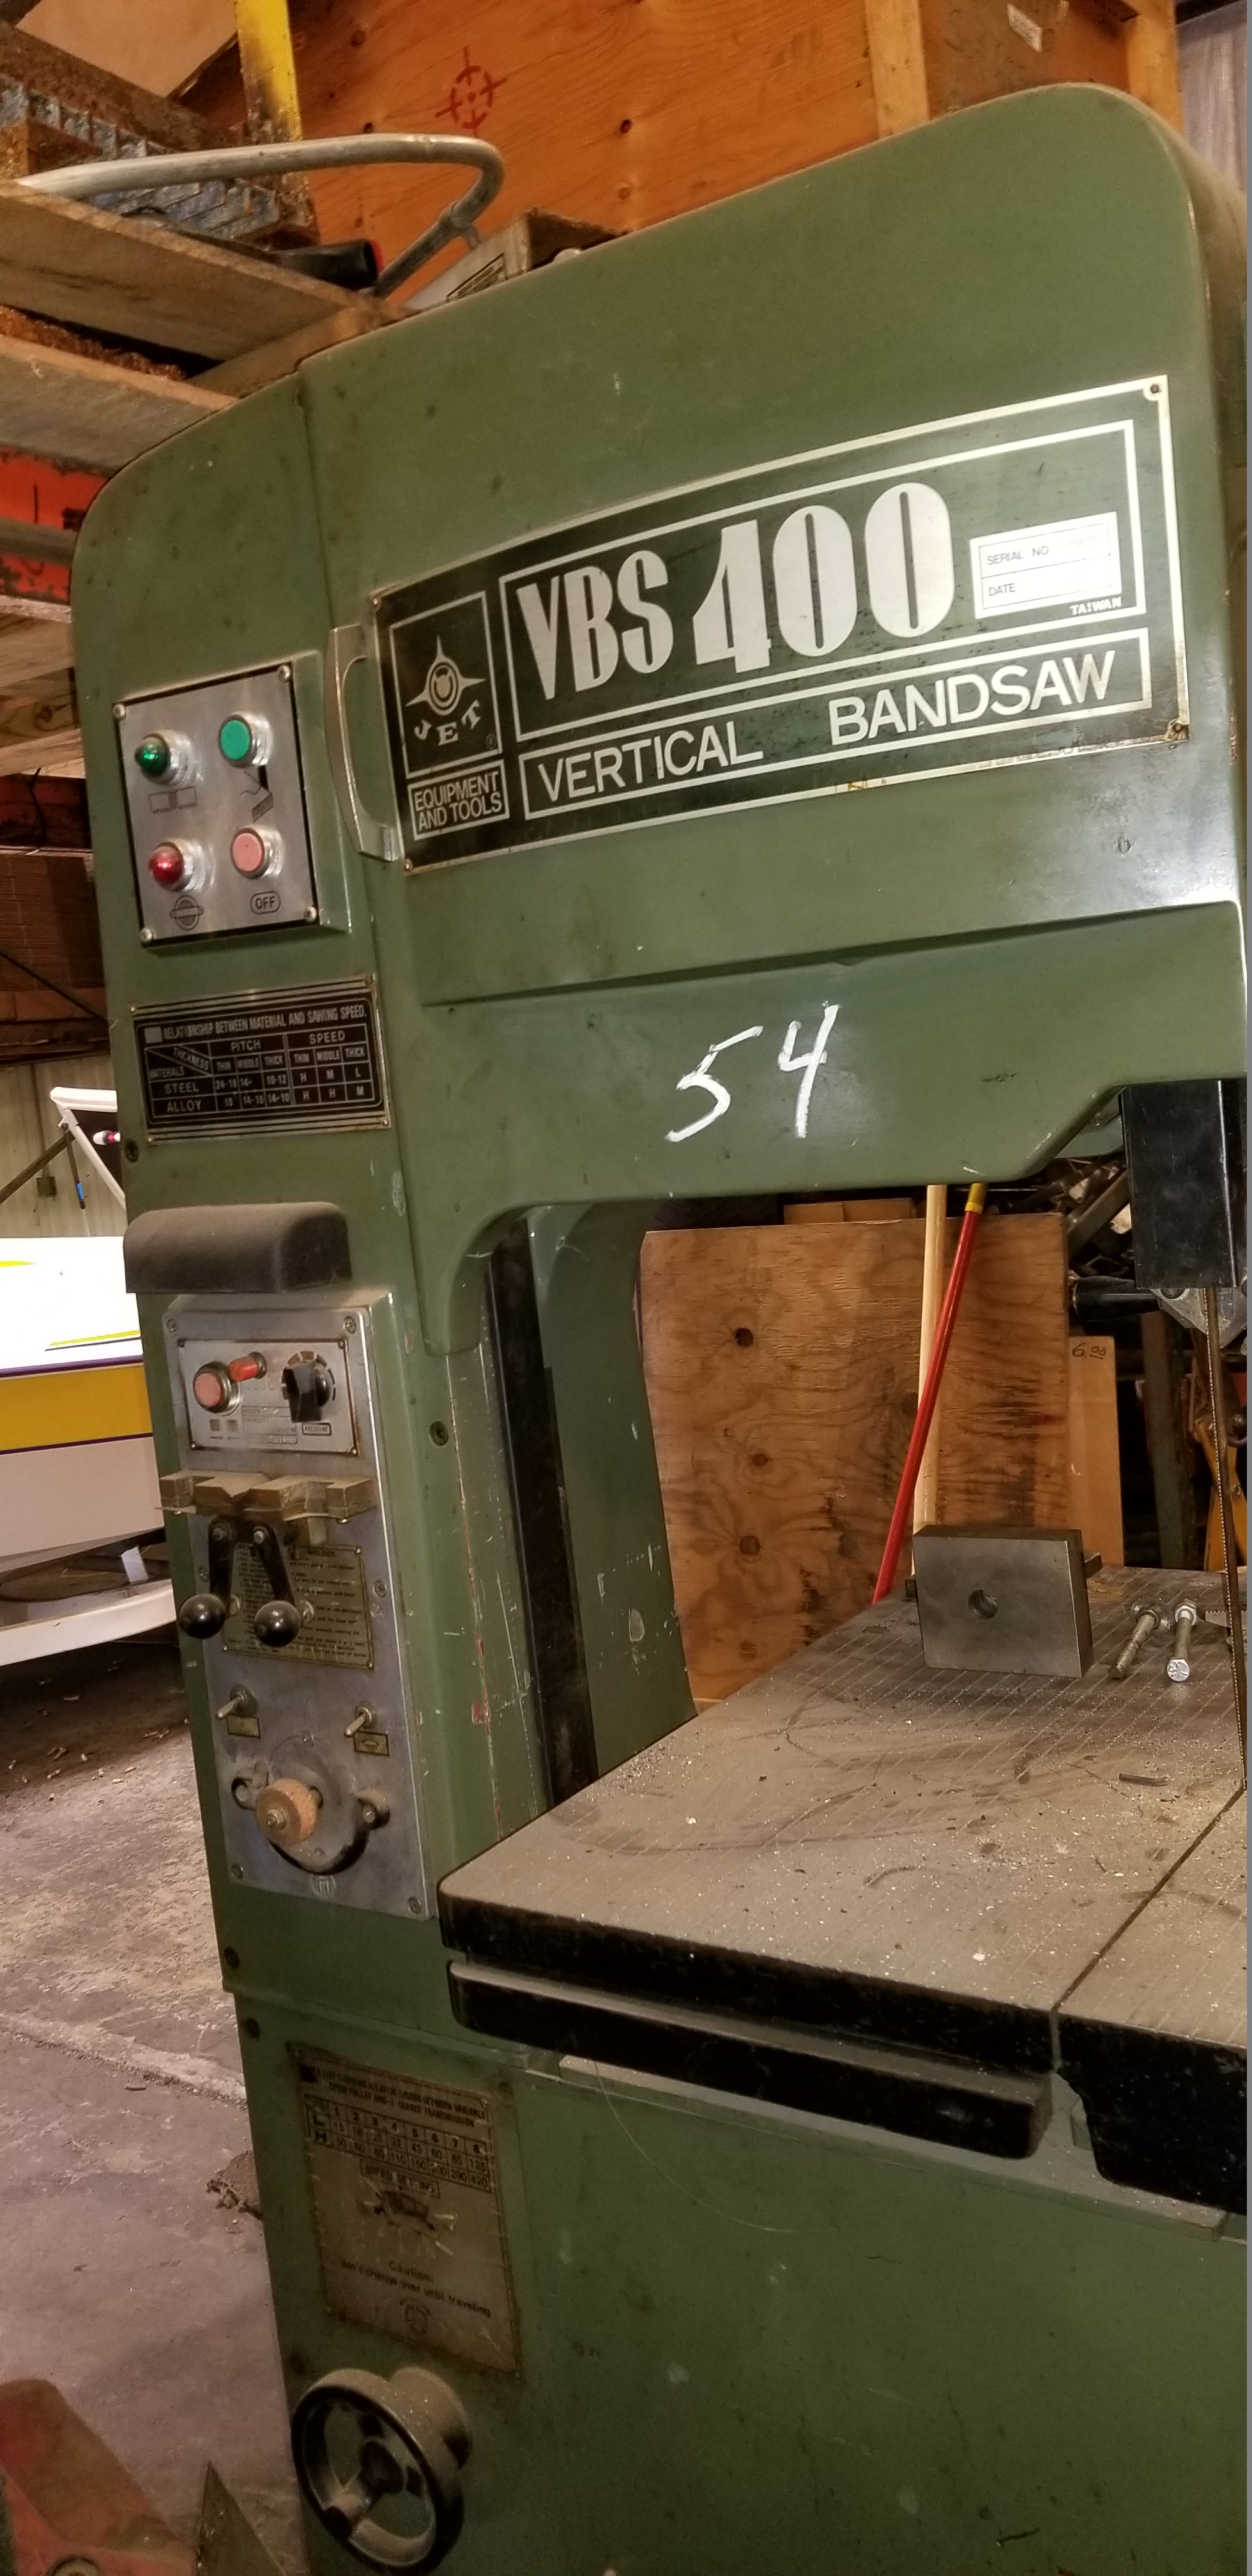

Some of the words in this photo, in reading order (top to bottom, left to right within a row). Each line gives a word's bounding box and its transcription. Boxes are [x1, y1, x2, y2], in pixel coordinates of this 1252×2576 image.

[987, 550, 1023, 565] SERIAL
[1032, 546, 1049, 556] NO
[516, 550, 673, 700] VBS
[692, 482, 954, 673] 400
[988, 583, 1016, 596] DATE
[1070, 596, 1122, 616] TAIWAN
[413, 700, 482, 746] JET
[538, 721, 763, 802] VERTICAL
[829, 650, 1115, 745] BANDSAW
[414, 771, 500, 812] EQUIPMENT
[418, 808, 447, 831] AND
[449, 792, 503, 821] TOOLS
[256, 896, 275, 909] OFF
[288, 1012, 305, 1026] AND
[231, 1039, 261, 1052] PITCH
[309, 1031, 345, 1045] SPEED
[345, 1046, 365, 1058] THICK
[174, 1046, 209, 1071] THICKNESS
[664, 1000, 839, 1142] 54
[164, 1082, 199, 1094] STEEL
[300, 1072, 307, 1082] H
[326, 1069, 334, 1080] M
[355, 1066, 361, 1077] L
[167, 1099, 201, 1113] ALLOY
[302, 1090, 310, 1100] H
[329, 1087, 336, 1098] H
[356, 1085, 364, 1096] M
